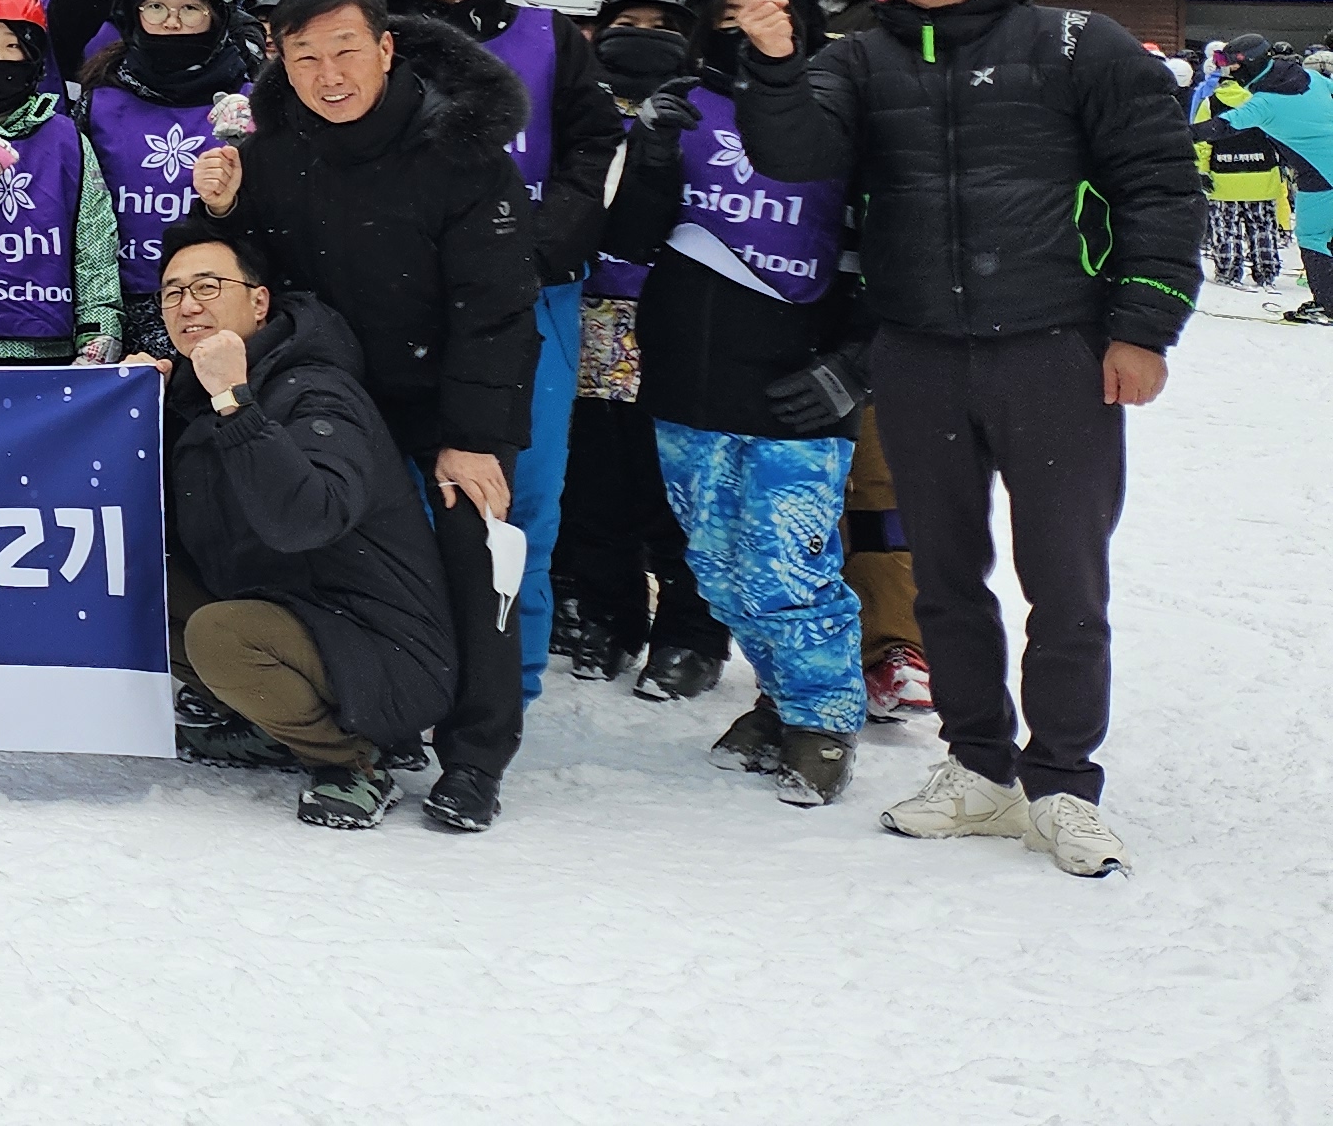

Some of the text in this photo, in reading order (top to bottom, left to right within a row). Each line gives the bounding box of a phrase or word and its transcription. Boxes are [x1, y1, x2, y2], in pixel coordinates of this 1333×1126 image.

[118, 185, 201, 222] high
[680, 183, 804, 226] high1
[730, 244, 818, 280] hool
